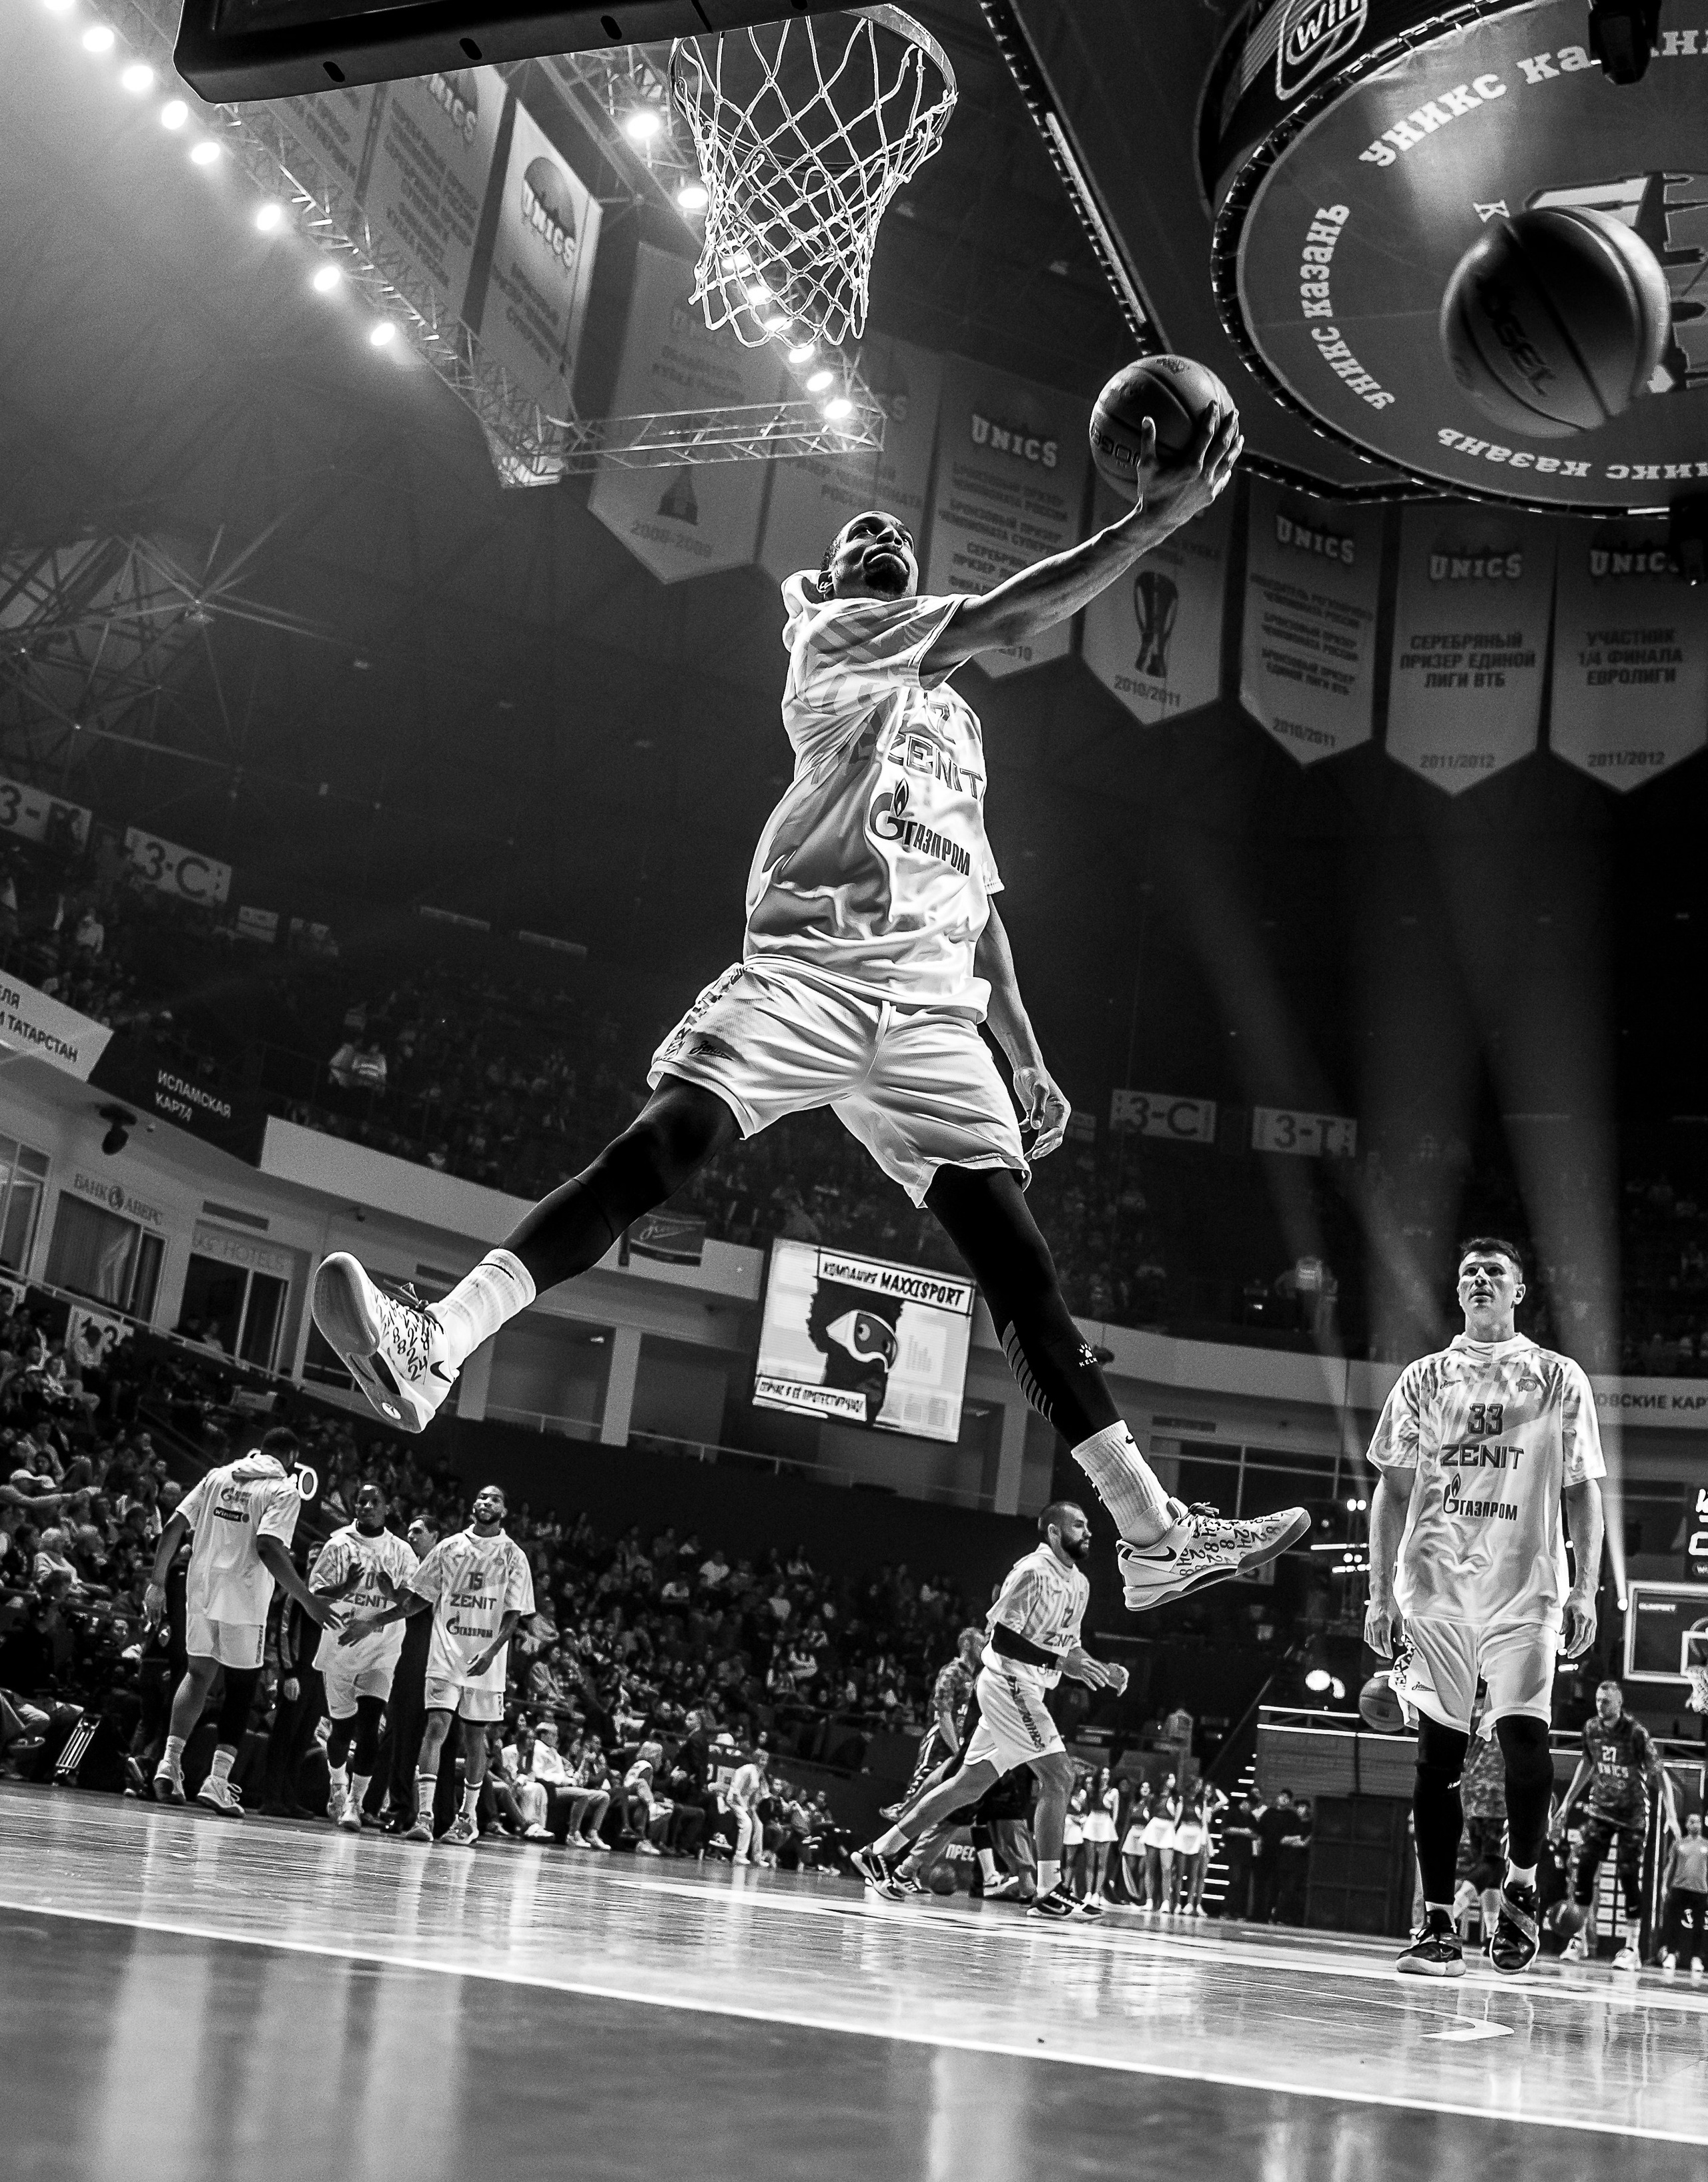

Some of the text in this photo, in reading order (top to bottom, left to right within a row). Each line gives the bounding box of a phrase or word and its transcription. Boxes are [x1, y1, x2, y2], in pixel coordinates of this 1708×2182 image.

[522, 177, 576, 267] UNICS
[971, 414, 1057, 467] UNICS
[1276, 514, 1354, 564] UNICS
[1428, 553, 1523, 580] UNICS
[1590, 549, 1679, 577] UNIC
[1410, 631, 1523, 650] СЕРЕБРЯНЫЙ
[1587, 628, 1675, 647] УЧАСТНИК
[1400, 651, 1536, 670] ПРИЗЕР ЕДИНОЙ
[1607, 647, 1683, 665] ФИНАЛА
[1424, 671, 1506, 688] ЛИГИ ВТБ
[1587, 668, 1677, 686] ЕВРОЛИГИ
[1114, 675, 1181, 707] 2010/2011
[1273, 717, 1336, 747] 2010/2011
[887, 734, 983, 799] ZENIT
[1419, 753, 1495, 769] 2011/2012
[1587, 751, 1665, 768] 2011/2012
[903, 820, 970, 876] ГАЗПРОМ
[7, 1014, 79, 1062] ТАТАРСТАН
[154, 1092, 193, 1122] КАРТА
[157, 1069, 232, 1119] ИСЛАМСКАЯ
[879, 1272, 965, 1307] MAXXISPORT
[1468, 1403, 1503, 1435] 33
[1440, 1443, 1525, 1469] ZENIT
[1458, 1498, 1518, 1521] ГАЗПРОМ
[468, 1572, 484, 1591] 15
[450, 1594, 497, 1610] ZENIT
